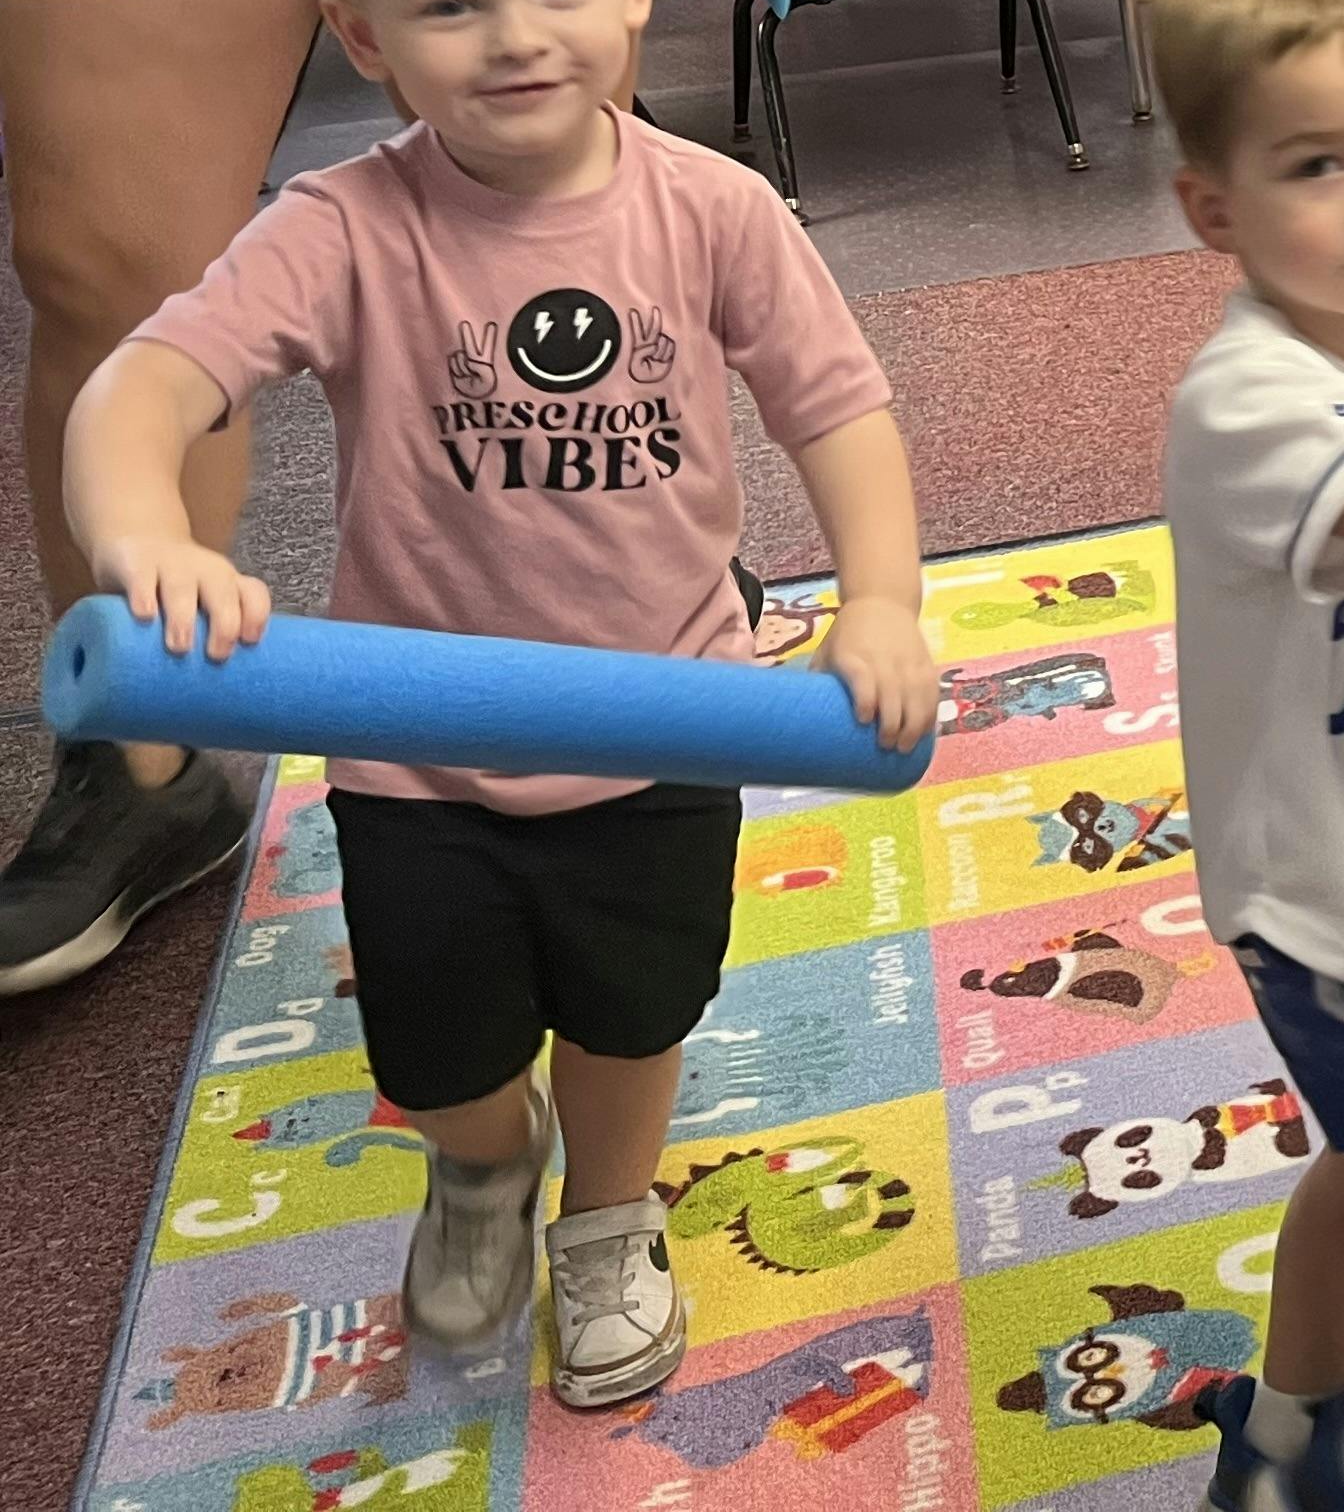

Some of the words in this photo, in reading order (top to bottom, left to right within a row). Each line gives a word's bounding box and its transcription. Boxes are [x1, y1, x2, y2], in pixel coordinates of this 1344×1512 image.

[432, 396, 682, 435] PRESCHOOL
[439, 428, 682, 493] VIBES
[868, 834, 908, 929] Kangaroo
[235, 924, 292, 969] Dog
[869, 942, 913, 1025] Jellyfish
